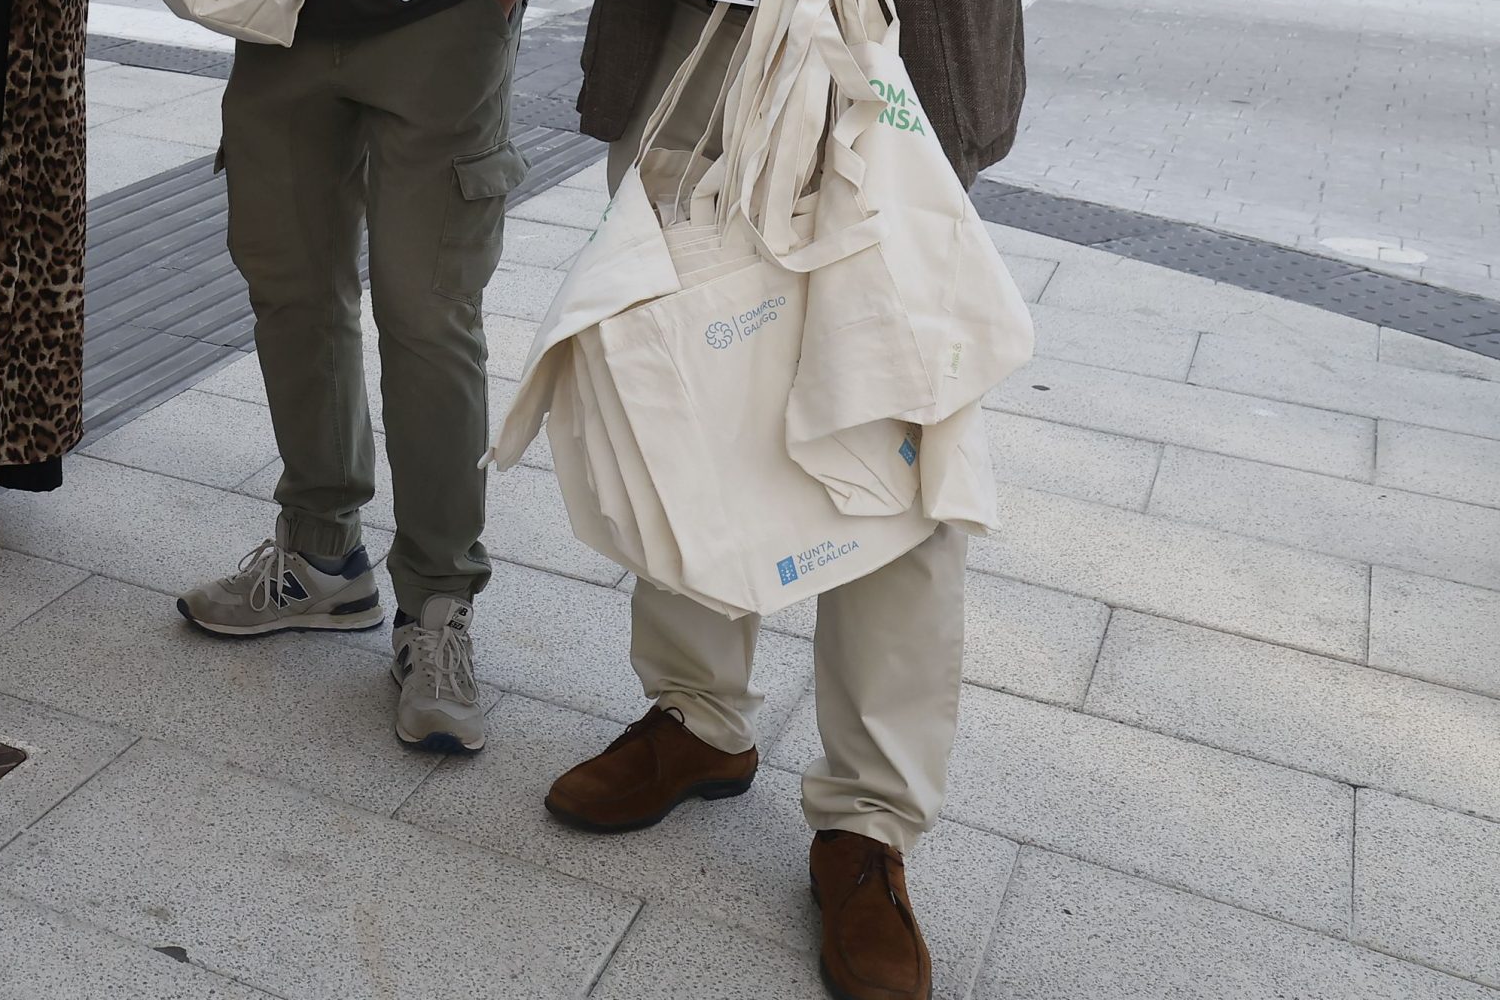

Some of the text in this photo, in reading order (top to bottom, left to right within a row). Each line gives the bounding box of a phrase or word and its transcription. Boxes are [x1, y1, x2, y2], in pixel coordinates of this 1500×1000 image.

[878, 106, 926, 137] NSA
[797, 540, 835, 564] XUNTA
[800, 540, 860, 575] DE GALICIA
